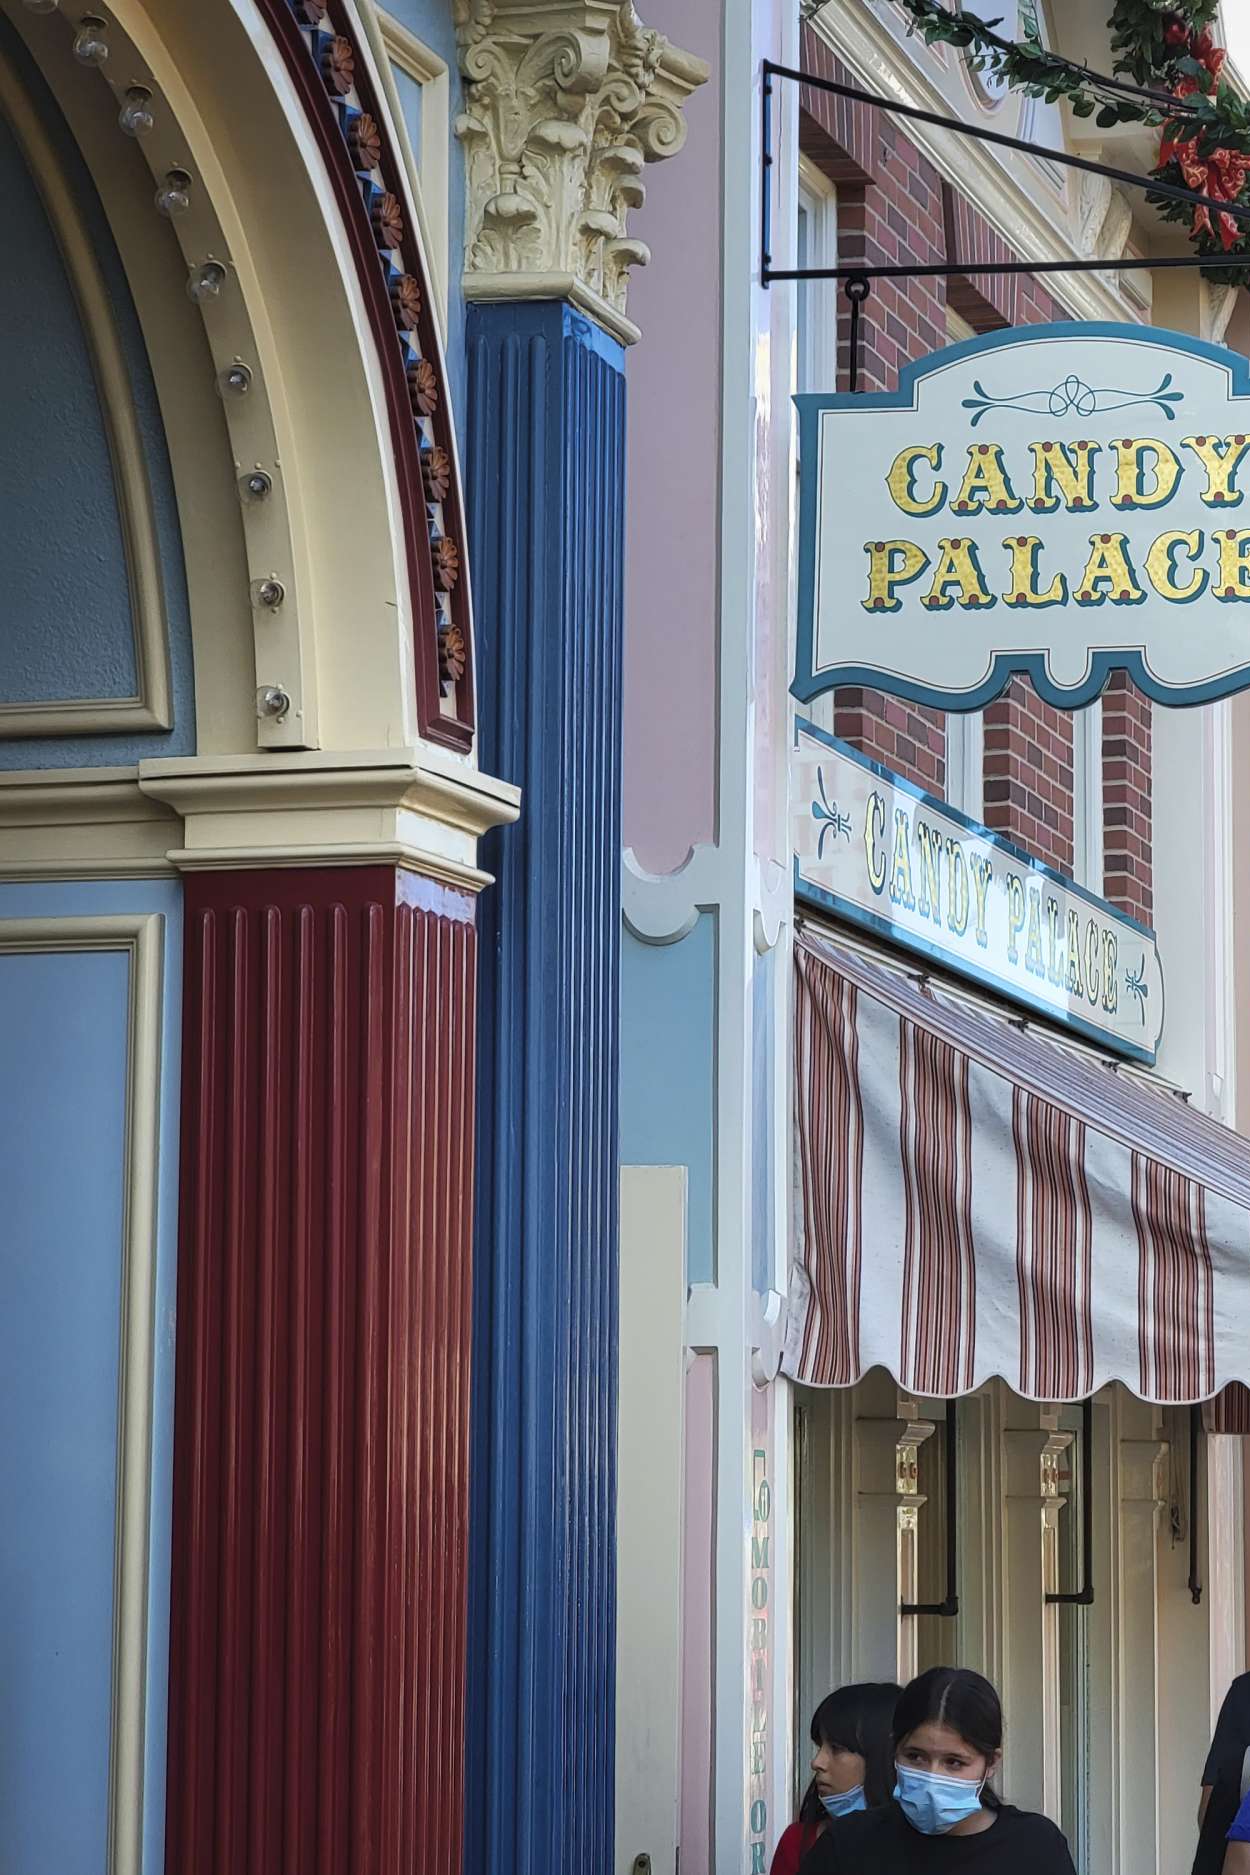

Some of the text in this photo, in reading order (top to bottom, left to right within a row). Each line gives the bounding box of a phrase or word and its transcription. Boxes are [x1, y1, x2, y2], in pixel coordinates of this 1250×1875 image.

[863, 789, 1119, 1015] CANDY PALACE
[751, 1536, 770, 1775] MOBILE
